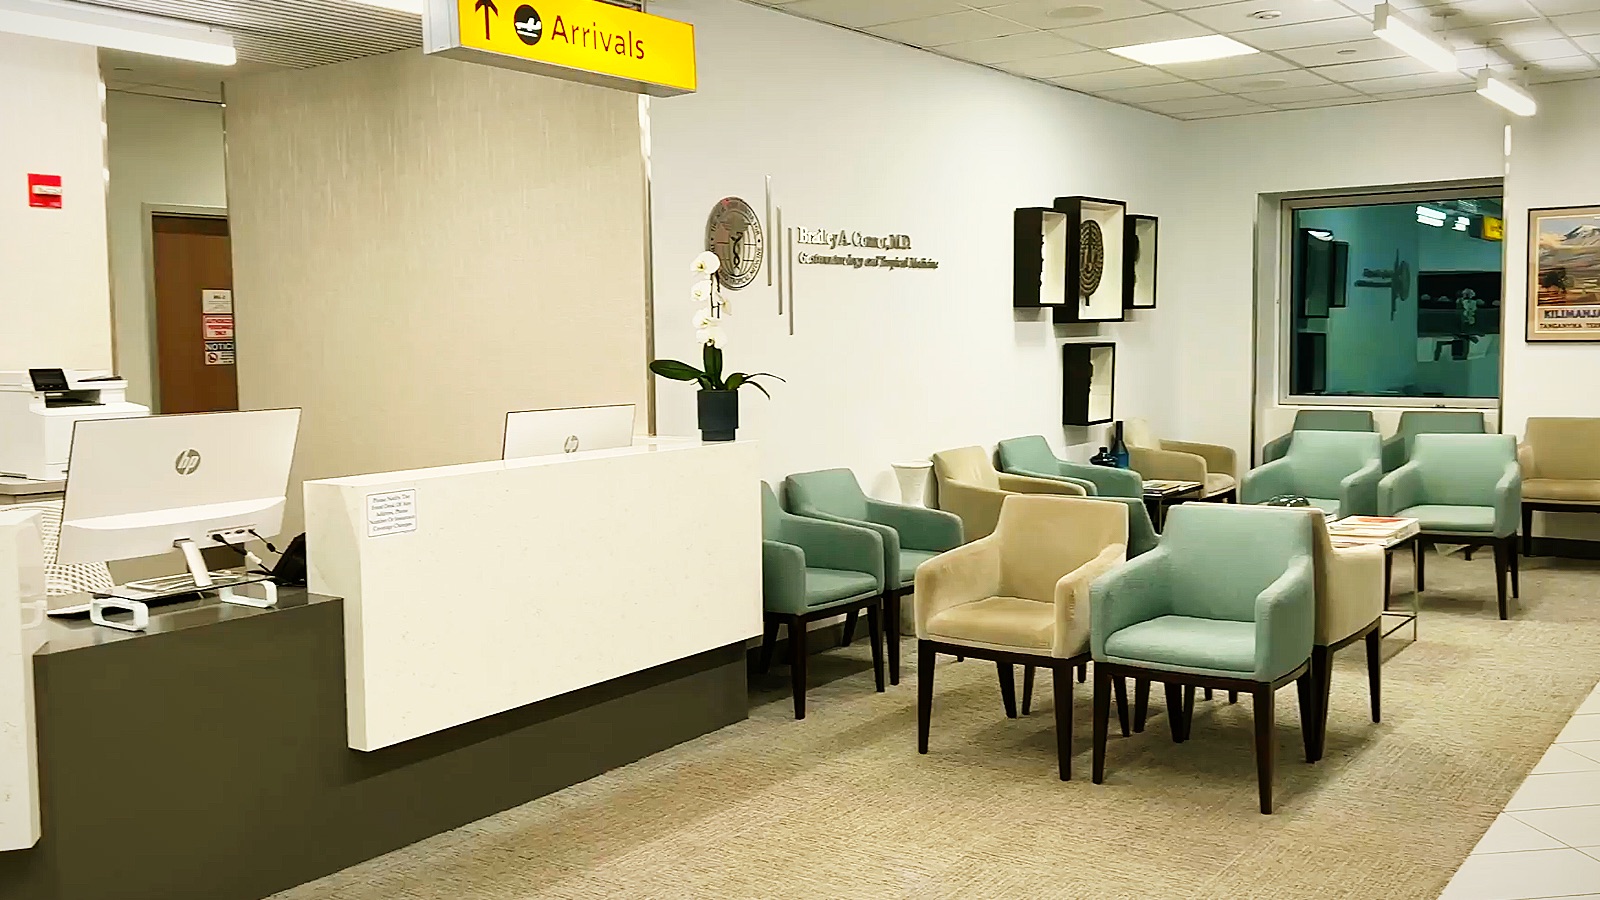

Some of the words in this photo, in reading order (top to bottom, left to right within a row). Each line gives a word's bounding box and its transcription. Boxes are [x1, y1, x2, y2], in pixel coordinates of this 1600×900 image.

[551, 15, 645, 60] Arrivals
[205, 343, 234, 351] NOTIC
[176, 449, 201, 475] hp
